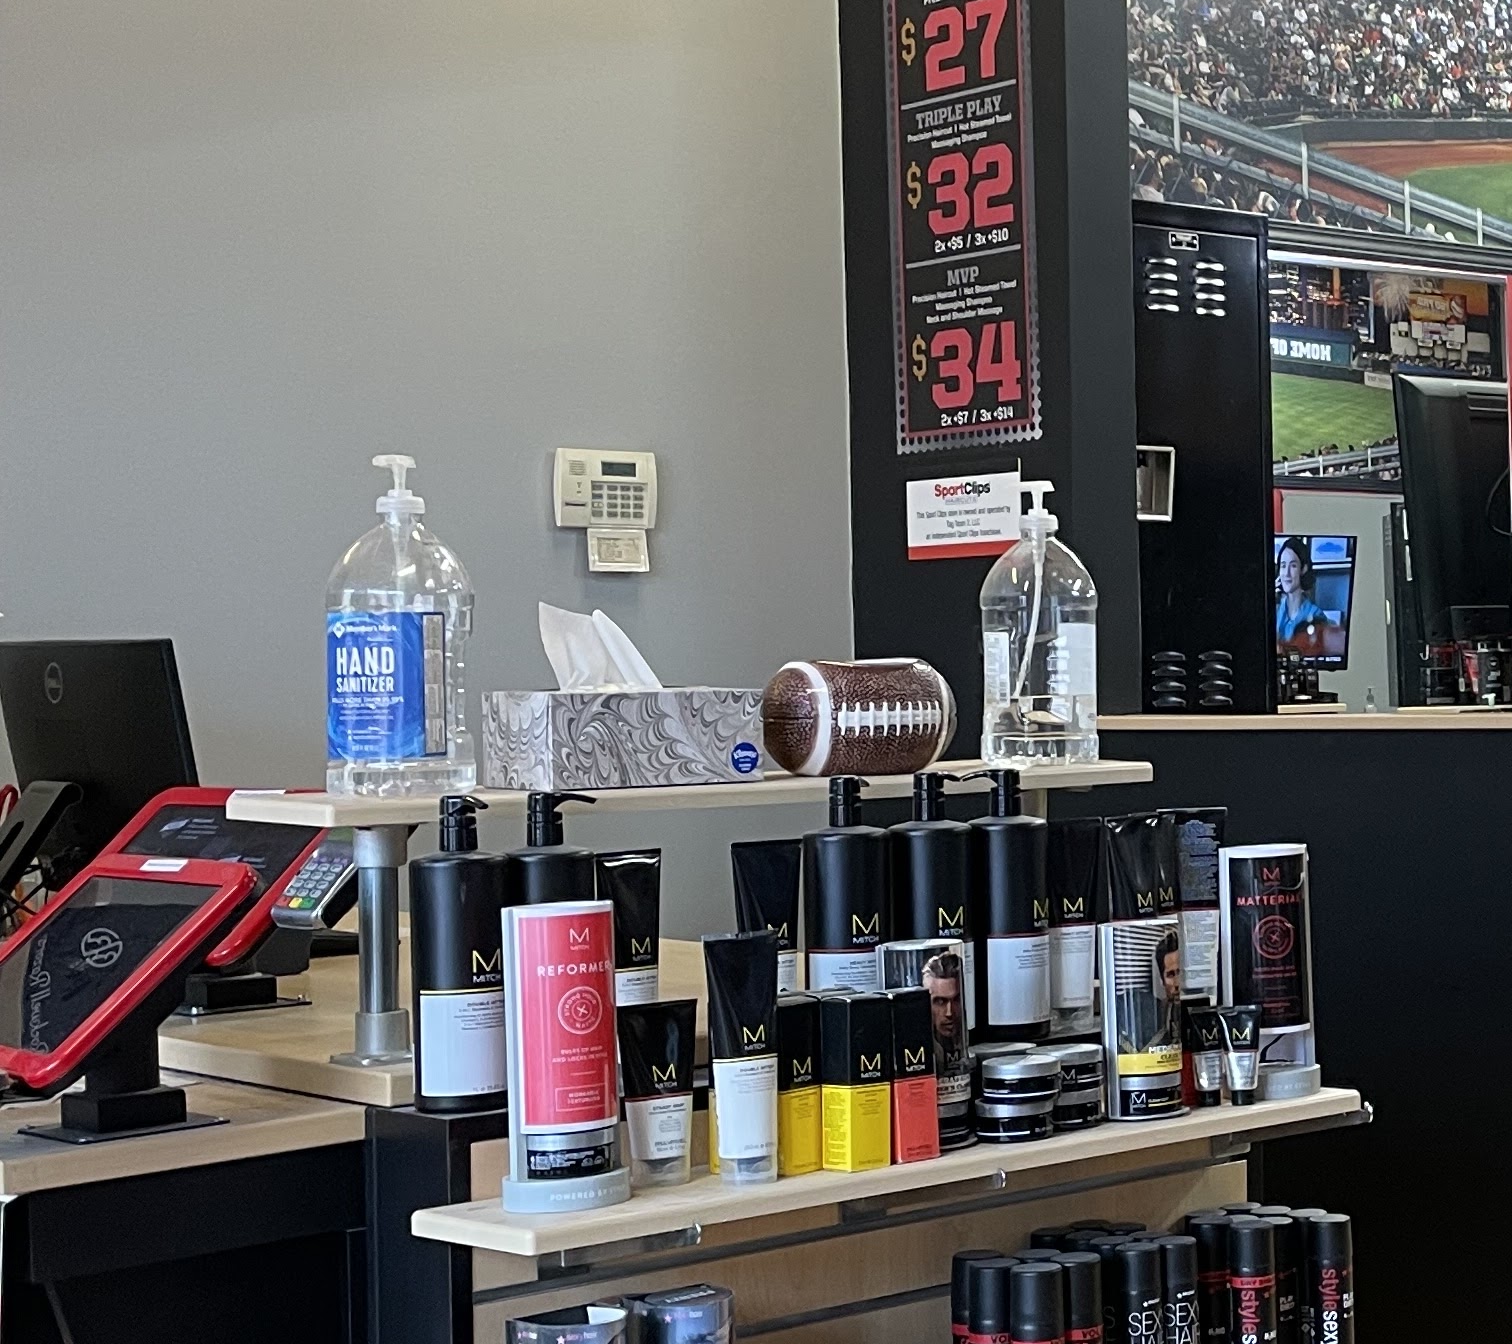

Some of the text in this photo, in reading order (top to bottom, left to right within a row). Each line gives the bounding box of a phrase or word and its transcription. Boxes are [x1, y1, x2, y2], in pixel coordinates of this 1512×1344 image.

[915, 94, 1002, 130] TRIPLE PLAY
[906, 142, 1014, 235] $32
[934, 239, 946, 253] 2x
[946, 265, 980, 287] MVP
[911, 320, 1022, 410] $34
[940, 413, 953, 427] 2x
[980, 408, 992, 422] 3x
[934, 481, 991, 500] SportClips
[335, 645, 396, 676] HAND
[335, 675, 395, 694] SANITIZER
[1137, 891, 1154, 908] M
[1159, 886, 1174, 902] M
[1063, 896, 1084, 913] M
[852, 912, 879, 936] M
[938, 905, 964, 928] M
[569, 927, 590, 945] M
[852, 935, 880, 945] MITCH
[938, 927, 964, 937] MITCH
[631, 936, 651, 956] M
[472, 948, 502, 974] M
[536, 960, 613, 978] REFORMER
[743, 1023, 766, 1044] M
[1202, 1027, 1219, 1043] M
[1232, 1027, 1250, 1041] M
[744, 1043, 766, 1052] MITCH
[904, 1046, 925, 1065] M
[792, 1055, 812, 1077] M
[860, 1052, 882, 1073] M
[652, 1063, 676, 1082] M
[654, 1081, 678, 1090] MITCH
[549, 1190, 596, 1201] POWERED
